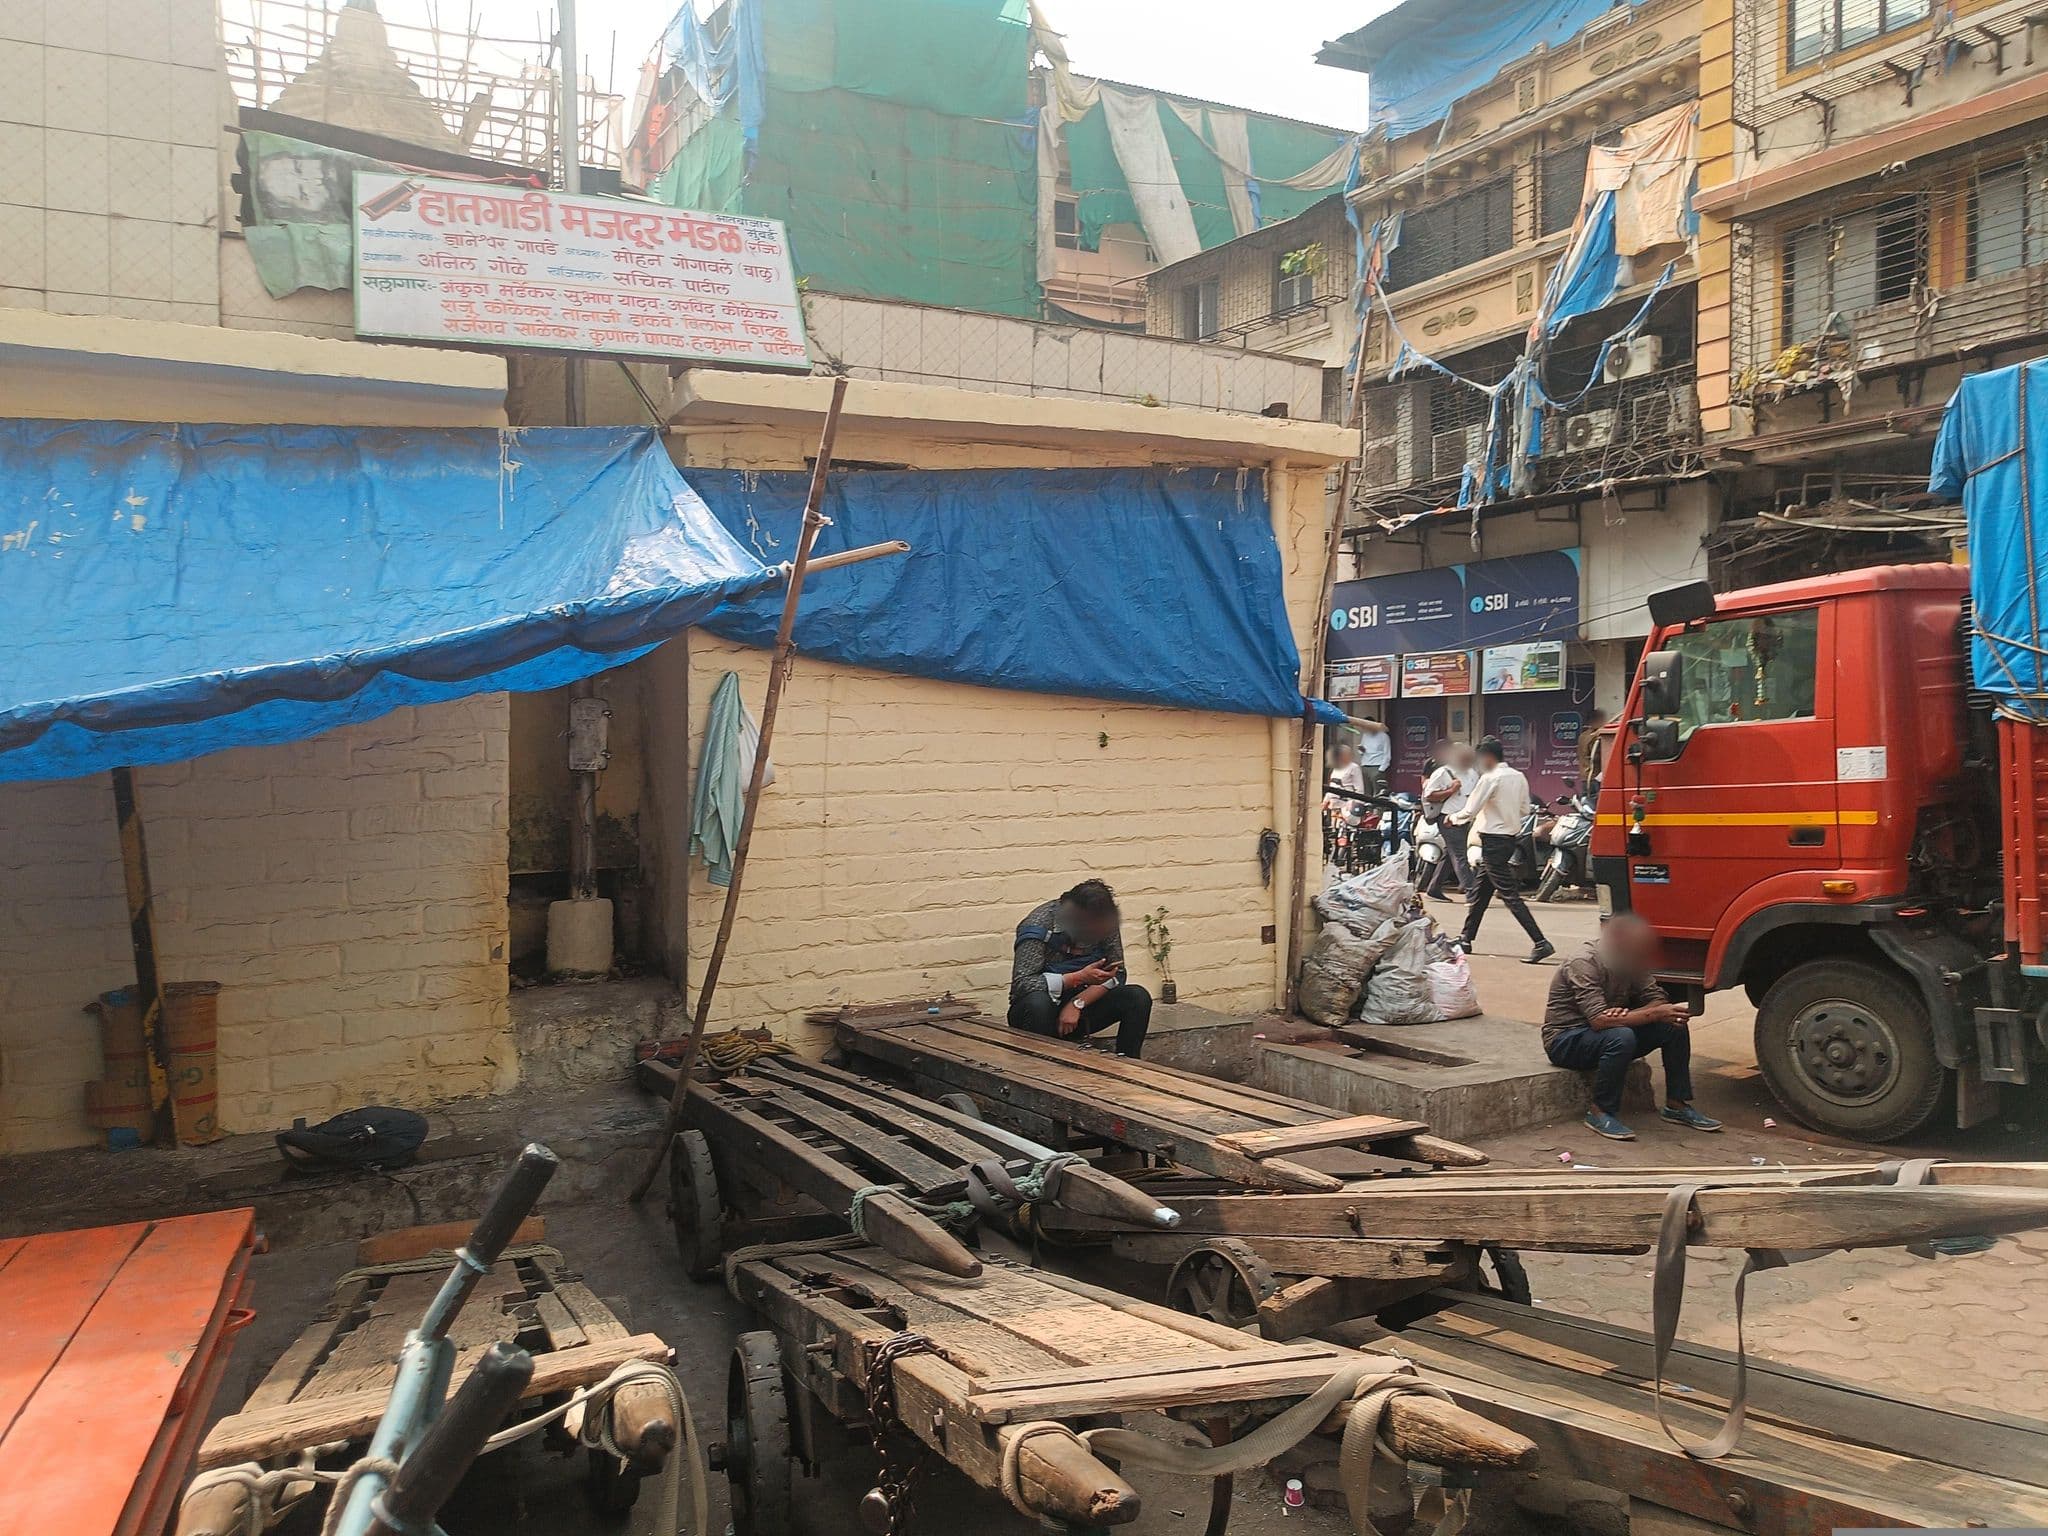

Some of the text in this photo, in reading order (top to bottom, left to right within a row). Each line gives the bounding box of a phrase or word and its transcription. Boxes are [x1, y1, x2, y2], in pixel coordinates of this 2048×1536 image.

[418, 189, 743, 253] हातगाडी मजदूर मंडळ
[514, 238, 560, 256] गावडे
[418, 251, 478, 271] अनिल
[487, 256, 529, 277] गोळे
[612, 247, 664, 269] मोहन
[670, 253, 733, 276] गोगावले
[613, 270, 674, 289] सचिन
[681, 278, 731, 297] पाटील
[440, 279, 490, 298] अंकुश
[563, 289, 614, 307] सुभाष
[617, 294, 660, 312] यादव
[721, 301, 779, 321] कोळेकर
[484, 299, 552, 320] कोळेकर
[560, 307, 622, 325] तानाजी
[680, 313, 735, 334] विलास
[513, 319, 579, 340] साळेकर
[589, 328, 640, 348] कुणाल
[689, 335, 753, 356] हनुमान
[759, 339, 806, 358] पाटील
[1484, 593, 1509, 612] SBI
[1348, 604, 1379, 629] SBI
[1553, 721, 1579, 732] yono
